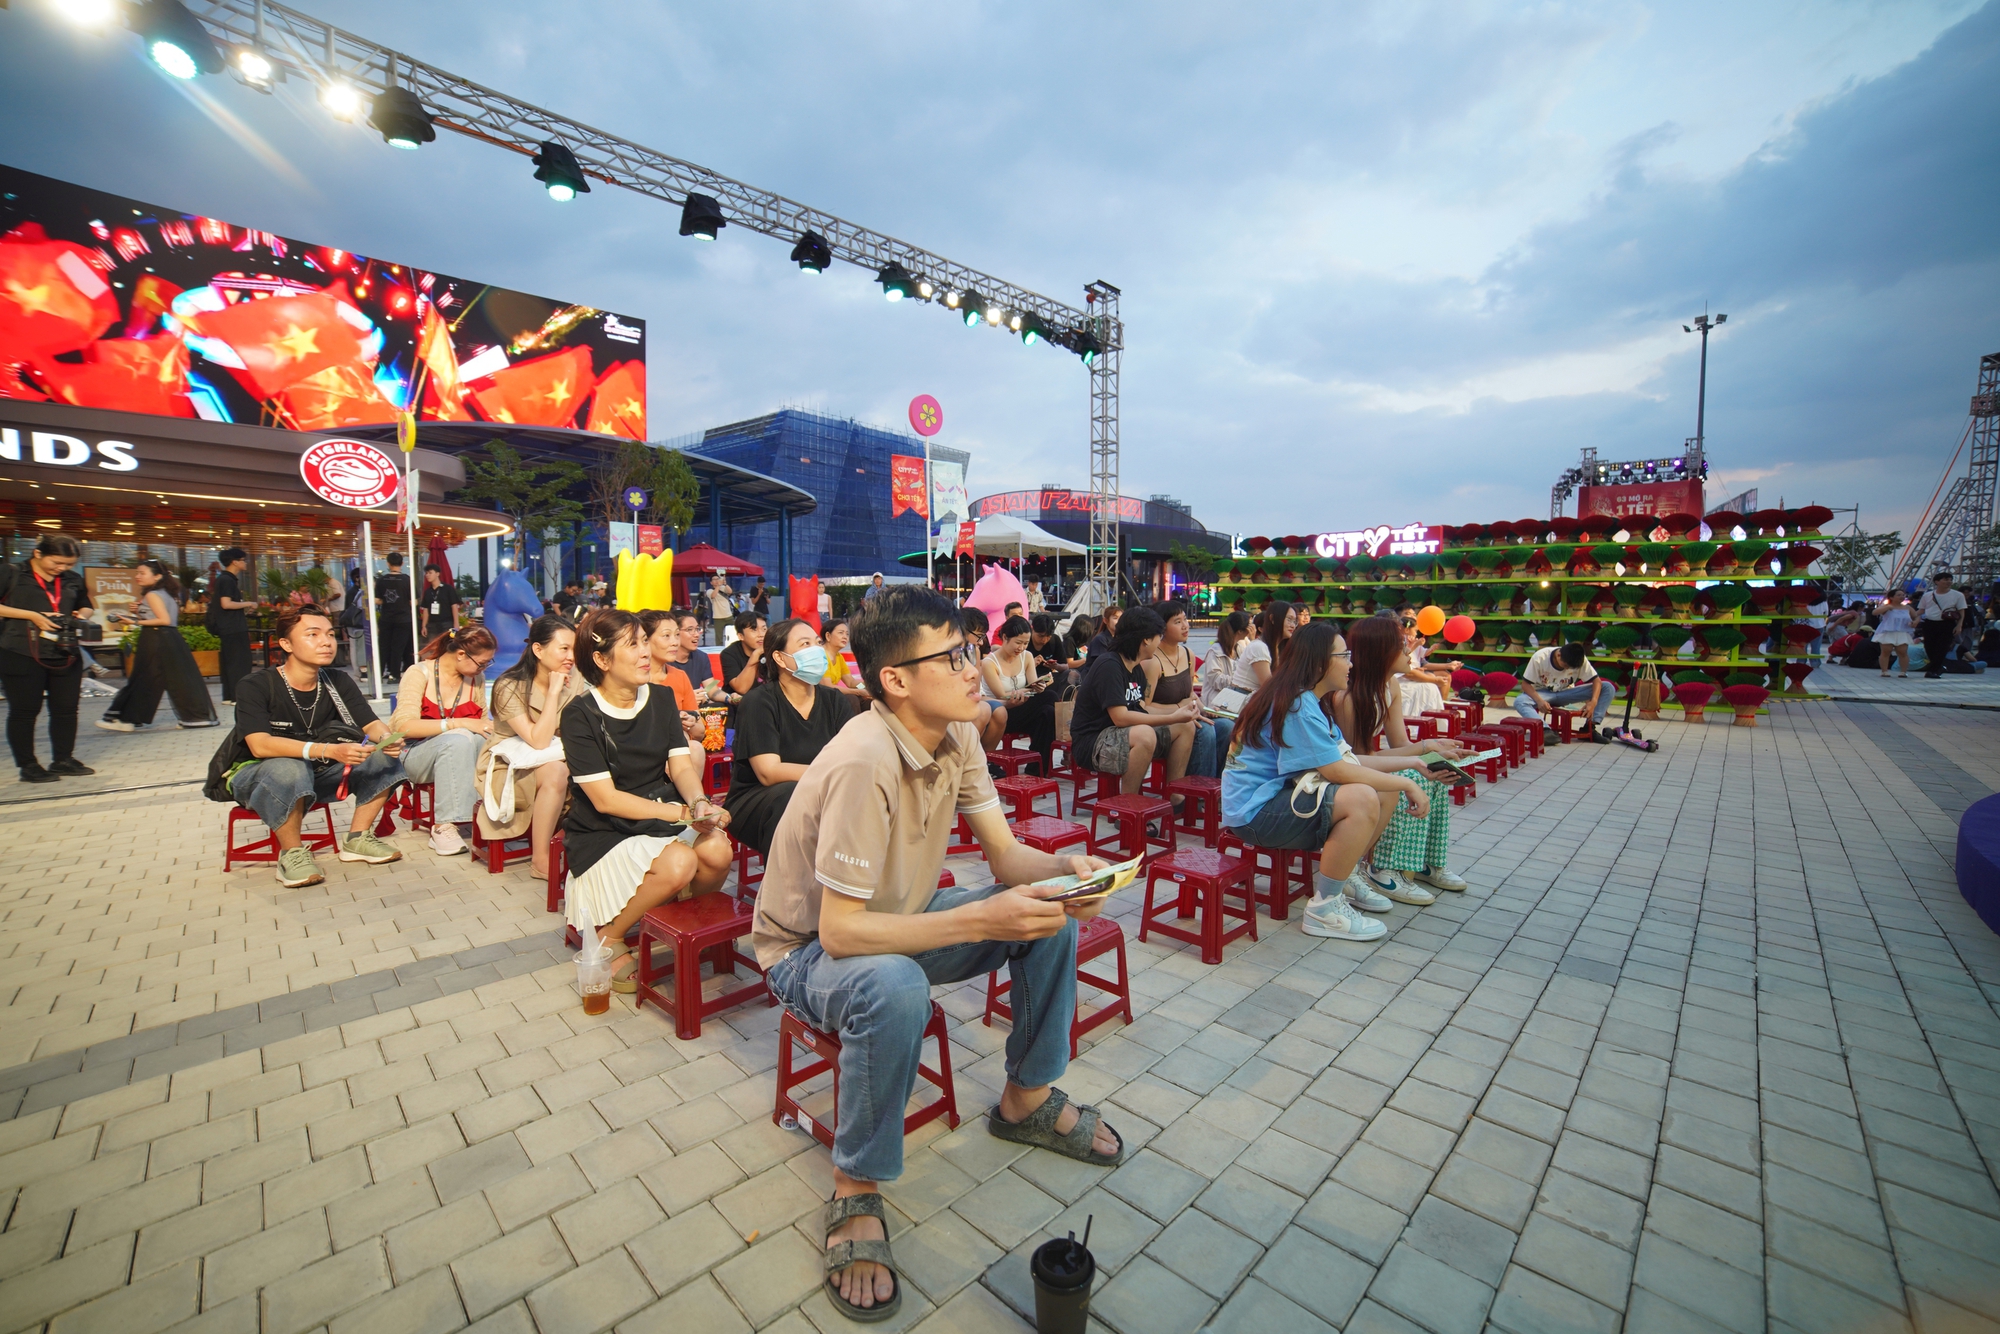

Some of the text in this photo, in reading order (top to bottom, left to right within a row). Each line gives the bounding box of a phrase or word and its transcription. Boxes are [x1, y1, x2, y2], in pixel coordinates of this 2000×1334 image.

[307, 443, 394, 476] HIGHLANDS
[319, 486, 386, 506] COFFEE
[980, 491, 1041, 516] ASIAN
[1616, 495, 1627, 503] 63
[1616, 504, 1624, 516] 1
[1391, 523, 1429, 542] TẾT
[1390, 540, 1440, 555] FEST
